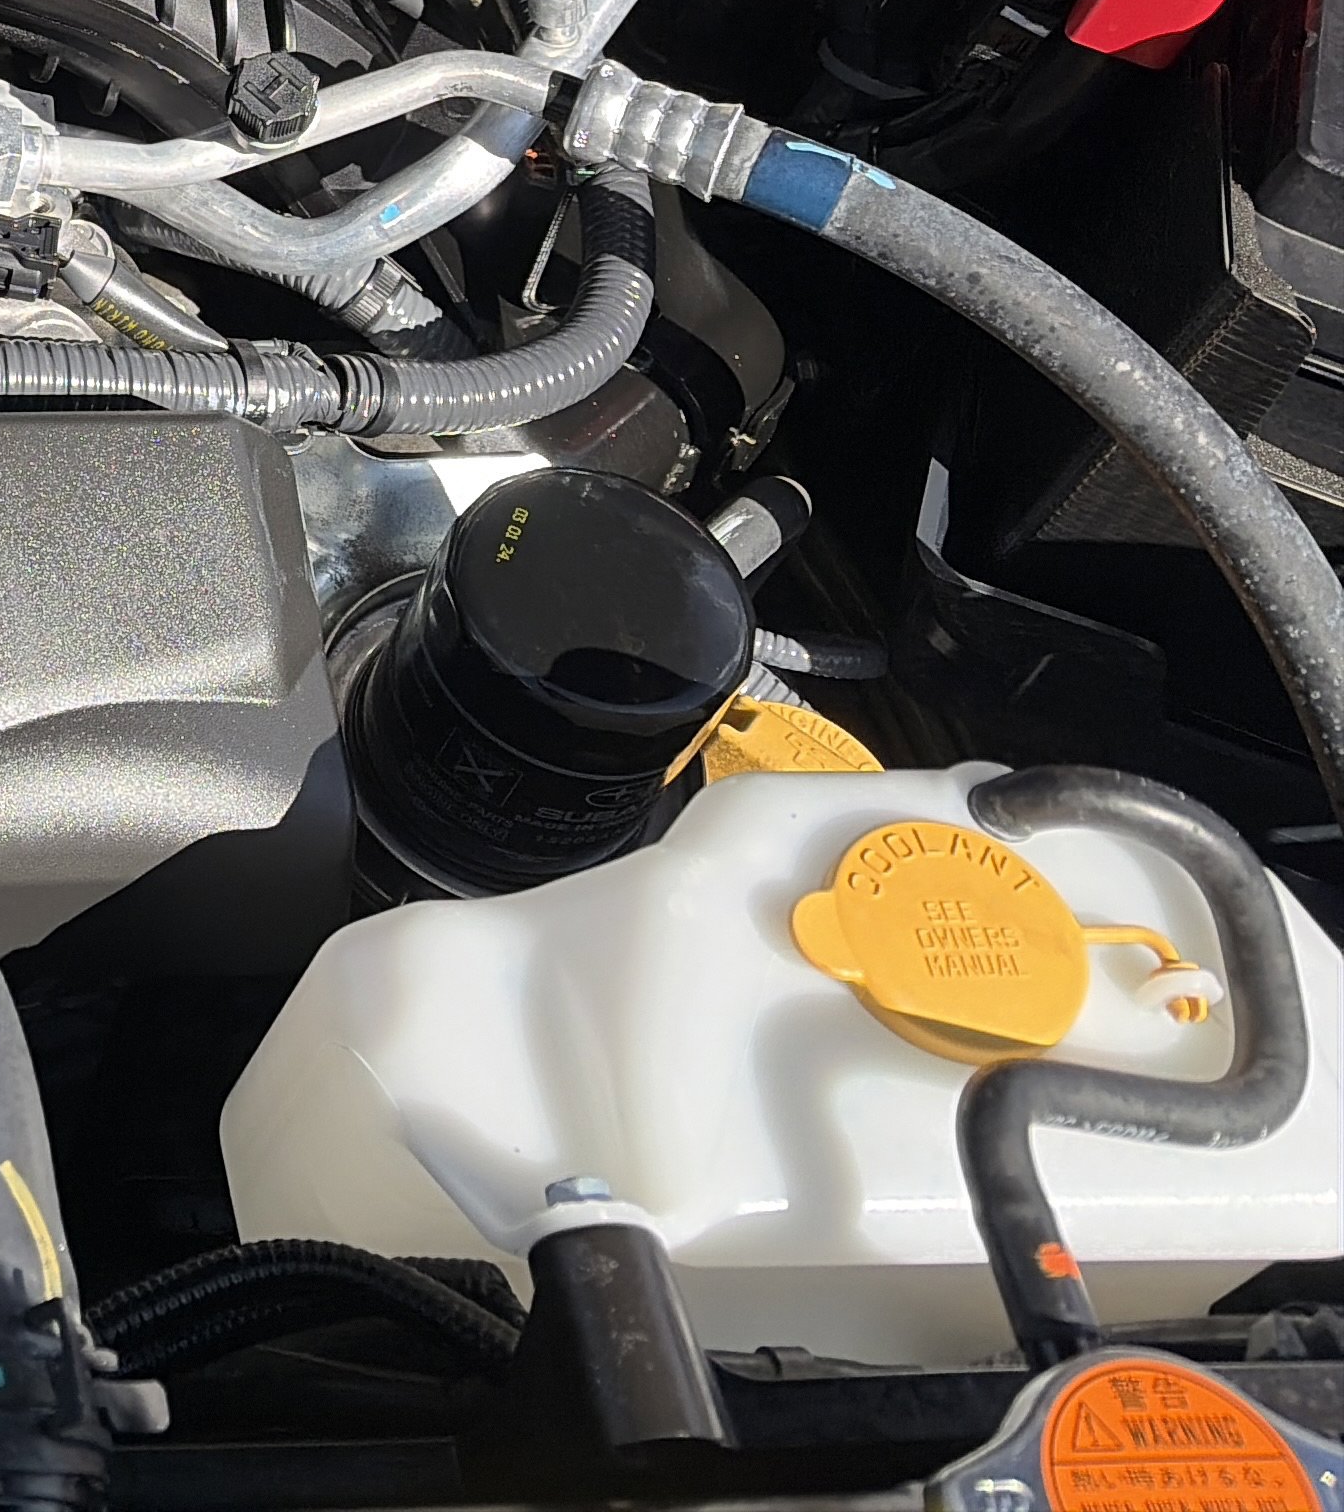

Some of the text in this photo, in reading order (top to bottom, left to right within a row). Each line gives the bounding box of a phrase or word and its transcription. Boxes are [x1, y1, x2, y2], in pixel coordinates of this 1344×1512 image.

[244, 58, 307, 115] H
[847, 828, 1040, 896] COOLANT
[922, 900, 978, 922] SEE
[915, 927, 1020, 949] OWNERS
[924, 953, 1029, 978] MANUAL
[1108, 1375, 1189, 1412] 警告
[1121, 1414, 1245, 1450] WARNING
